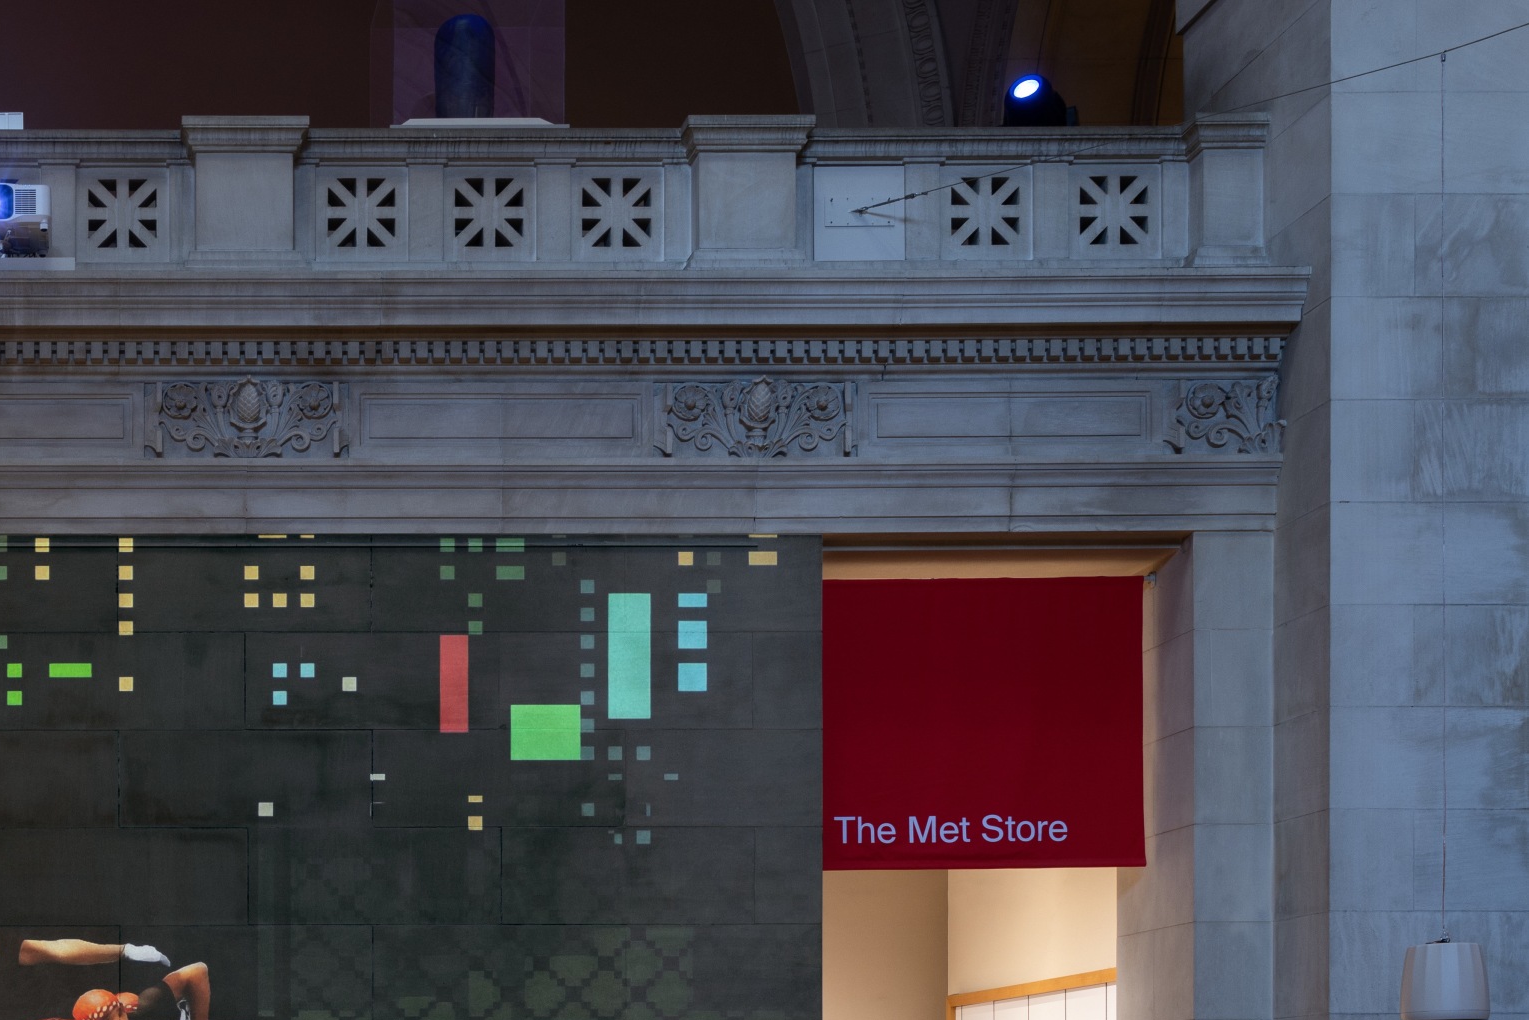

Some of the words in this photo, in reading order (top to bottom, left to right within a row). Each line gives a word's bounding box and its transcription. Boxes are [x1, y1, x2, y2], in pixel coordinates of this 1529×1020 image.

[834, 816, 896, 844] The
[908, 815, 971, 844] Met
[981, 814, 1068, 842] Store
